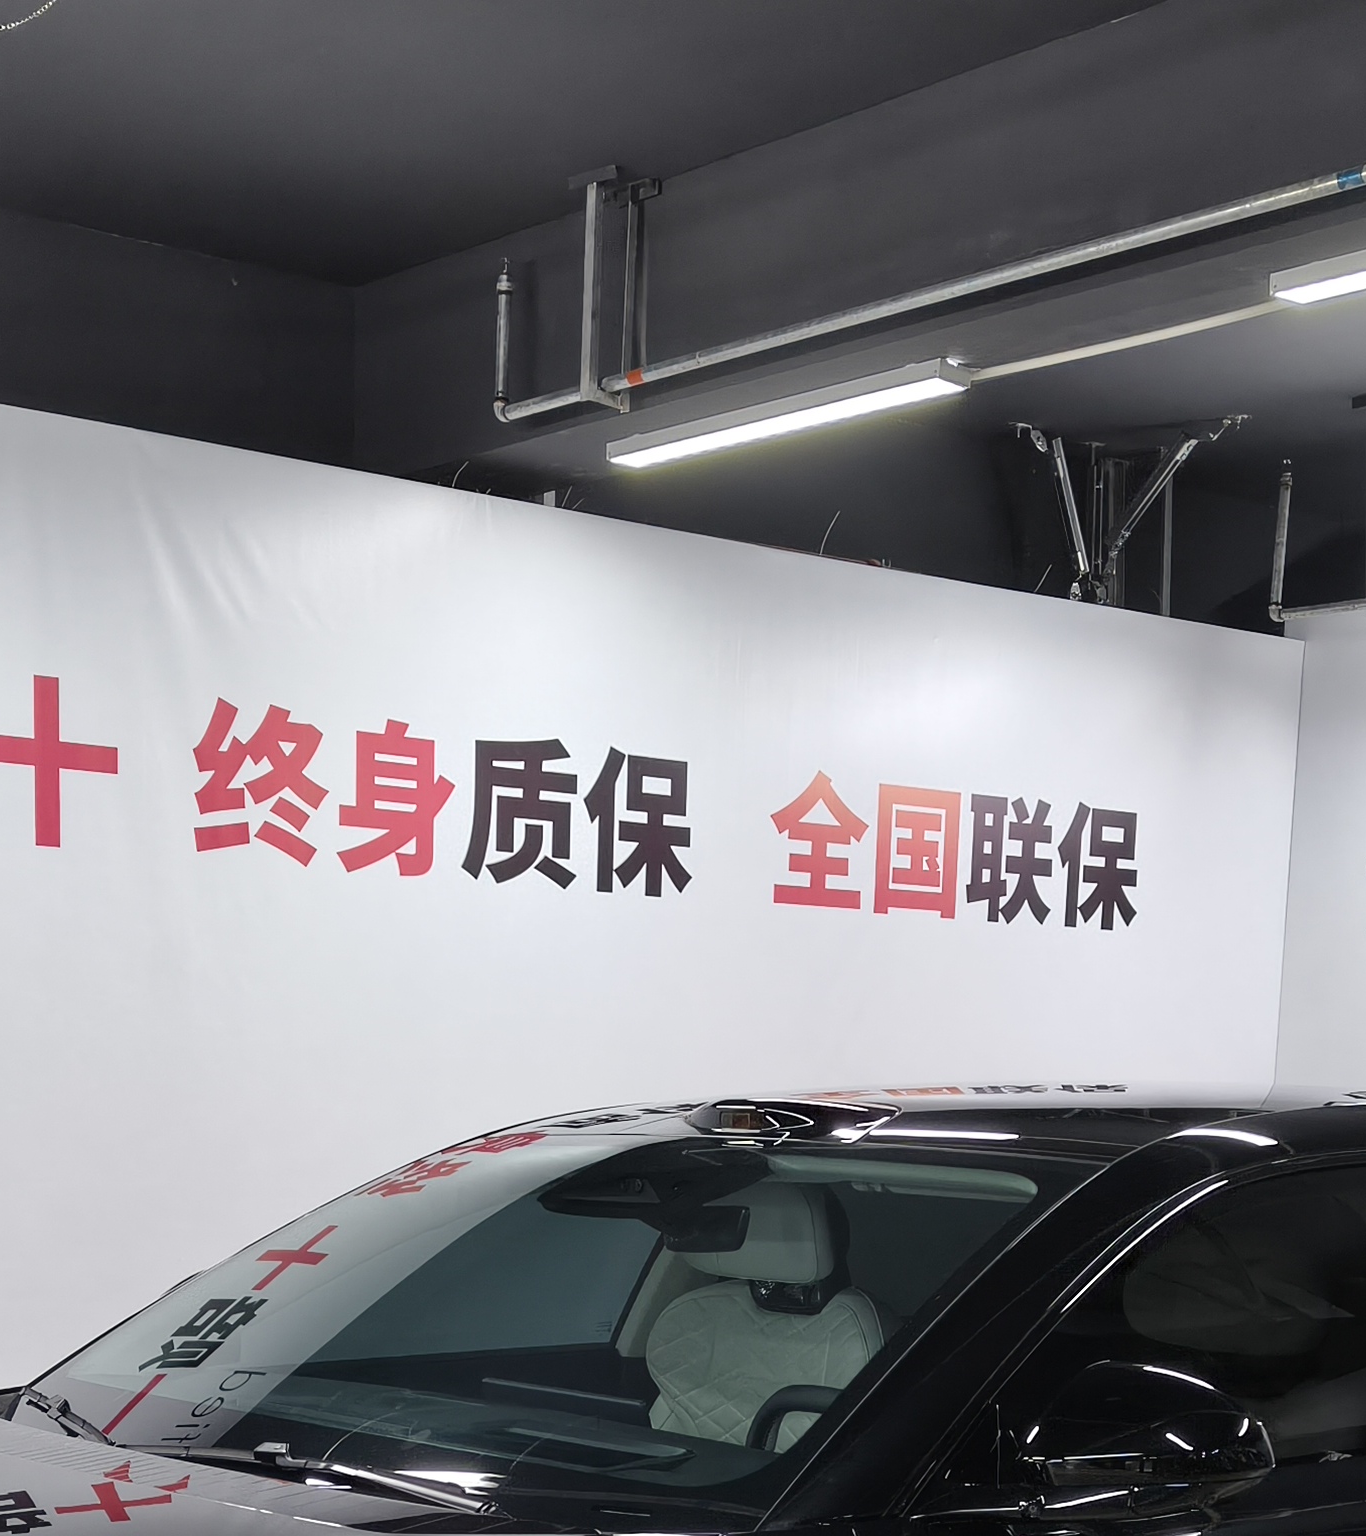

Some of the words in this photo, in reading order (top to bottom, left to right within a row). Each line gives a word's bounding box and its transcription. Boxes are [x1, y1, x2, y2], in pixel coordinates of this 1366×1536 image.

[192, 696, 693, 898] 终身质保
[769, 770, 1139, 932] 全国联保
